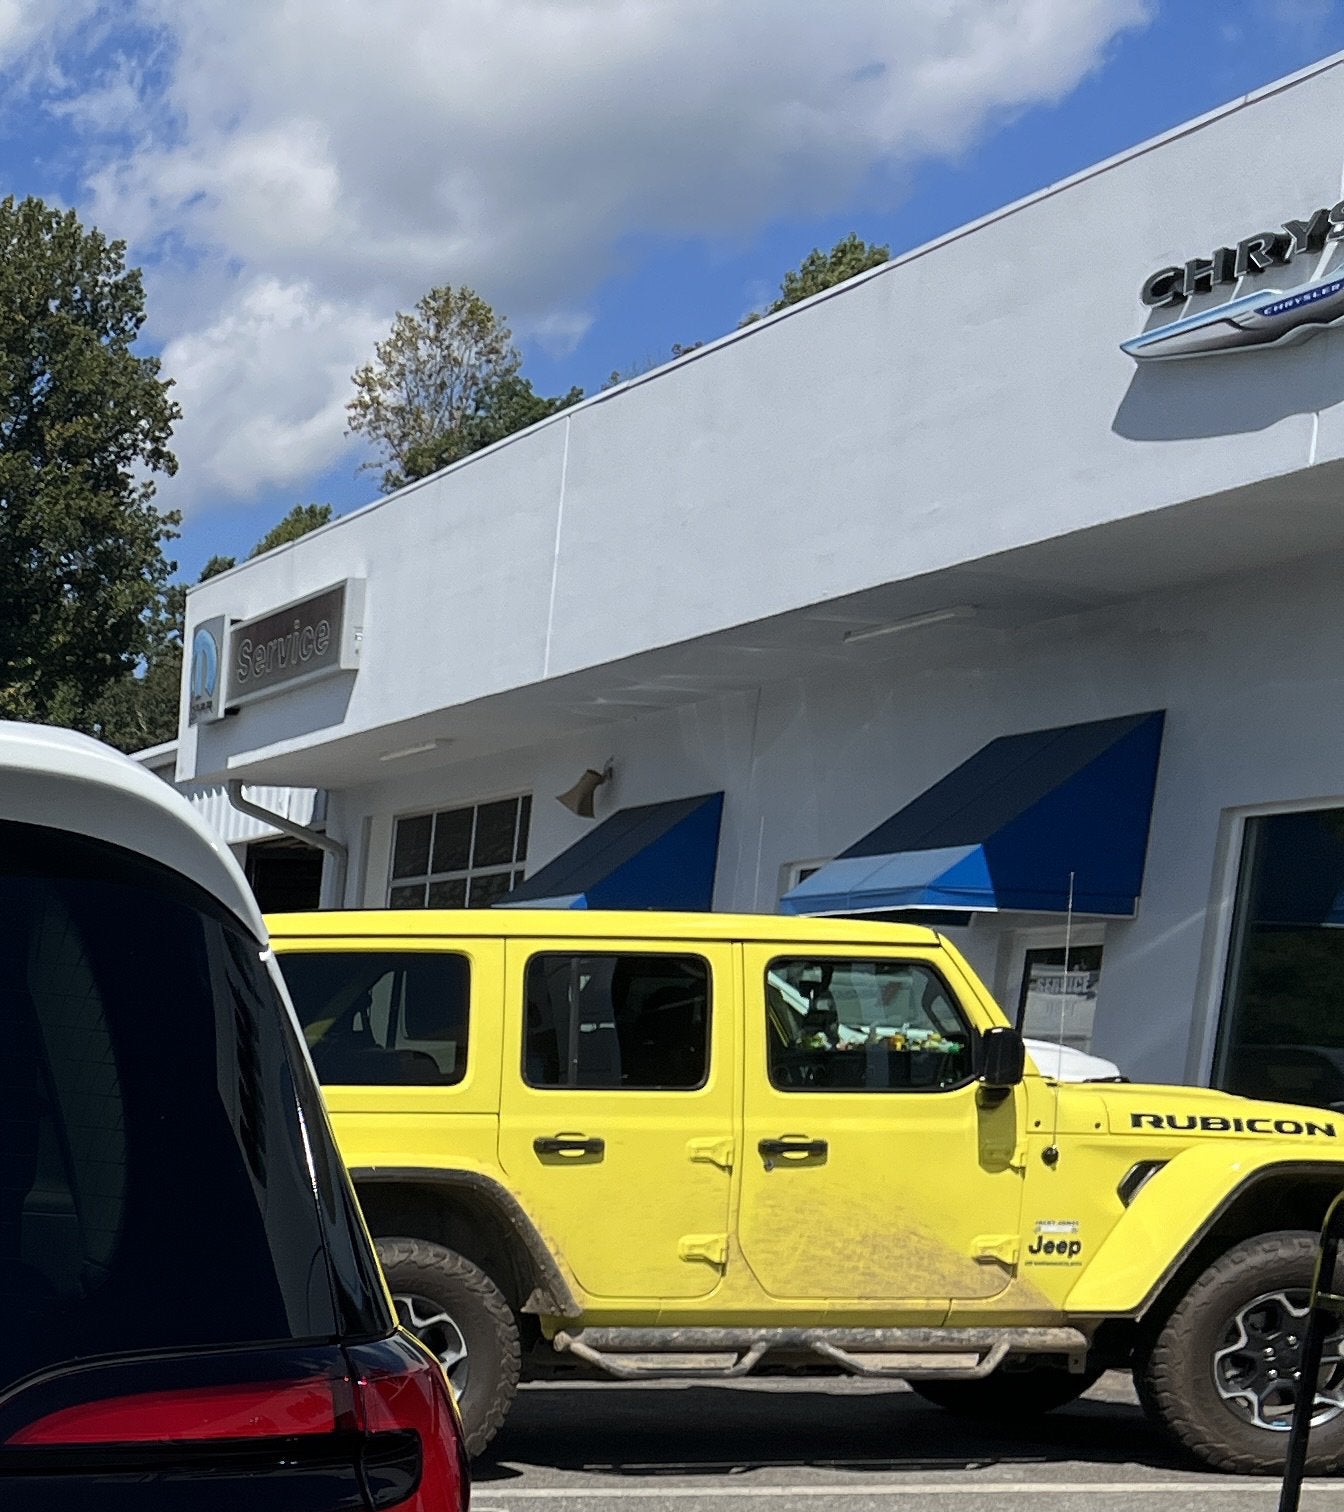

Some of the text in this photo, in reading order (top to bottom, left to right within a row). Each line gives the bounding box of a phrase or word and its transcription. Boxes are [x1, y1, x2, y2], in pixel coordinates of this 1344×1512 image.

[1263, 283, 1341, 315] CHRYSLER
[237, 618, 330, 684] Service
[1130, 1113, 1337, 1137] RUBICON
[1028, 1235, 1081, 1259] Jeep
